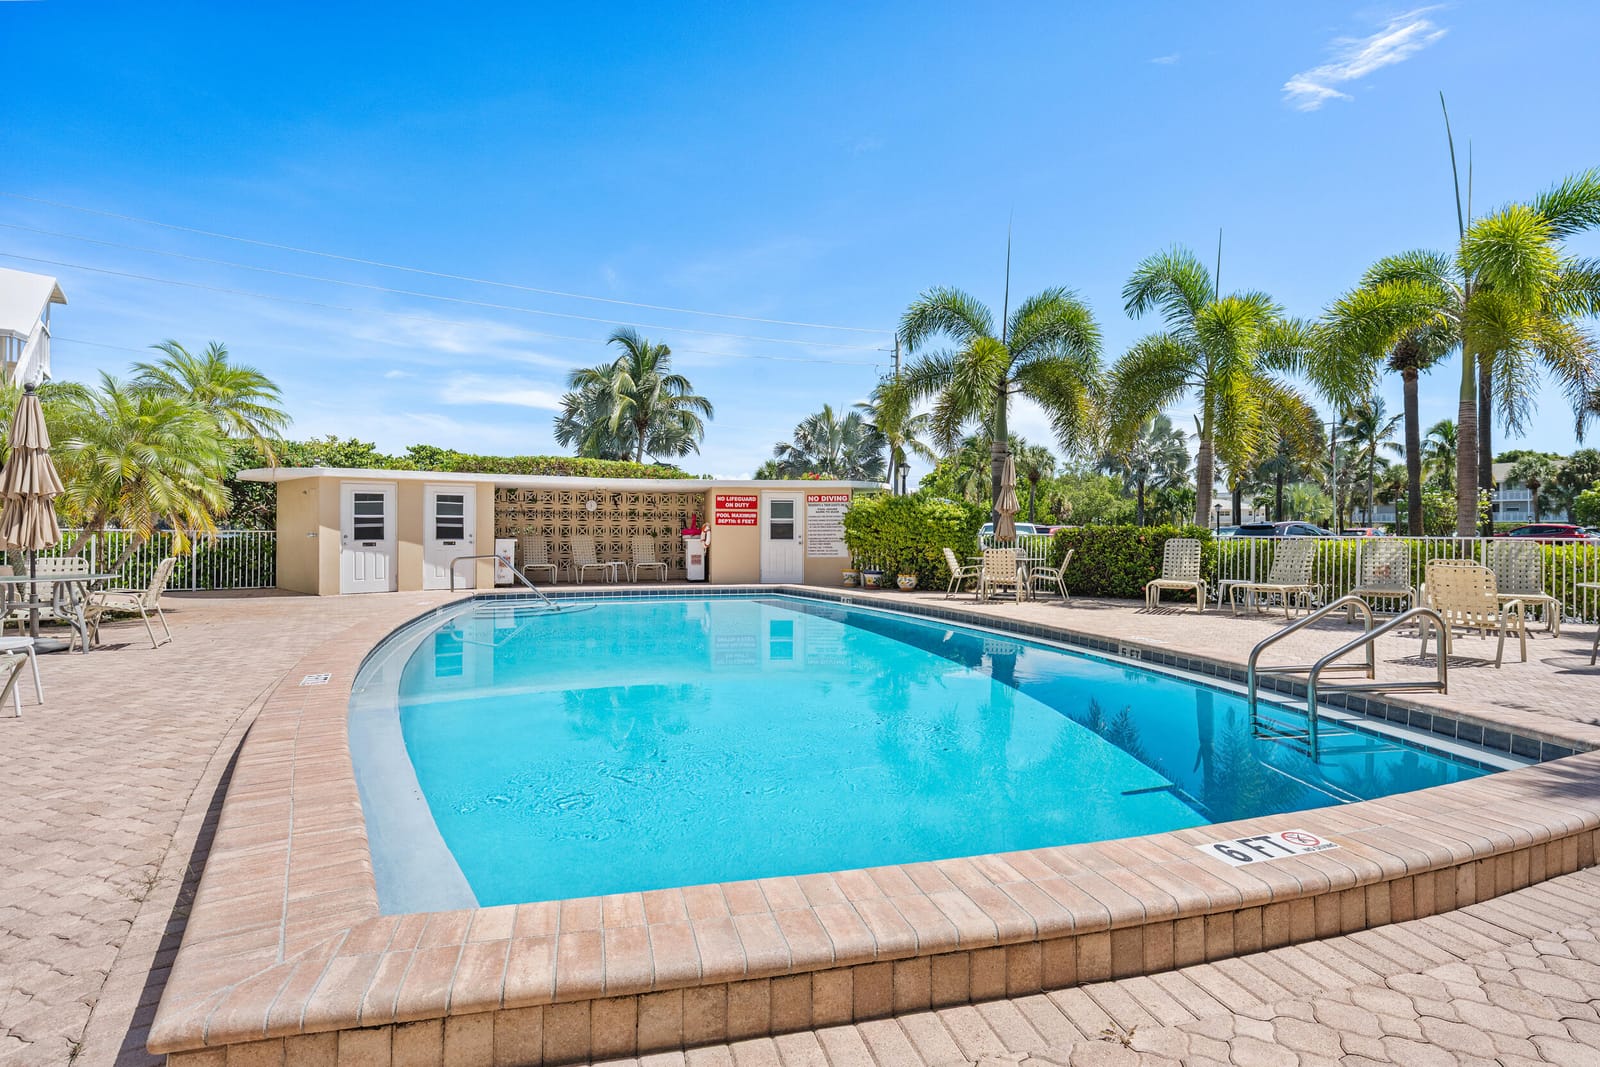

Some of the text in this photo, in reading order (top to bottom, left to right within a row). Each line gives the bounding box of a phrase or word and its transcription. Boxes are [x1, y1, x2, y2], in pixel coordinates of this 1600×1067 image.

[1121, 647, 1127, 656] 5
[1213, 835, 1297, 862] 6 FT
